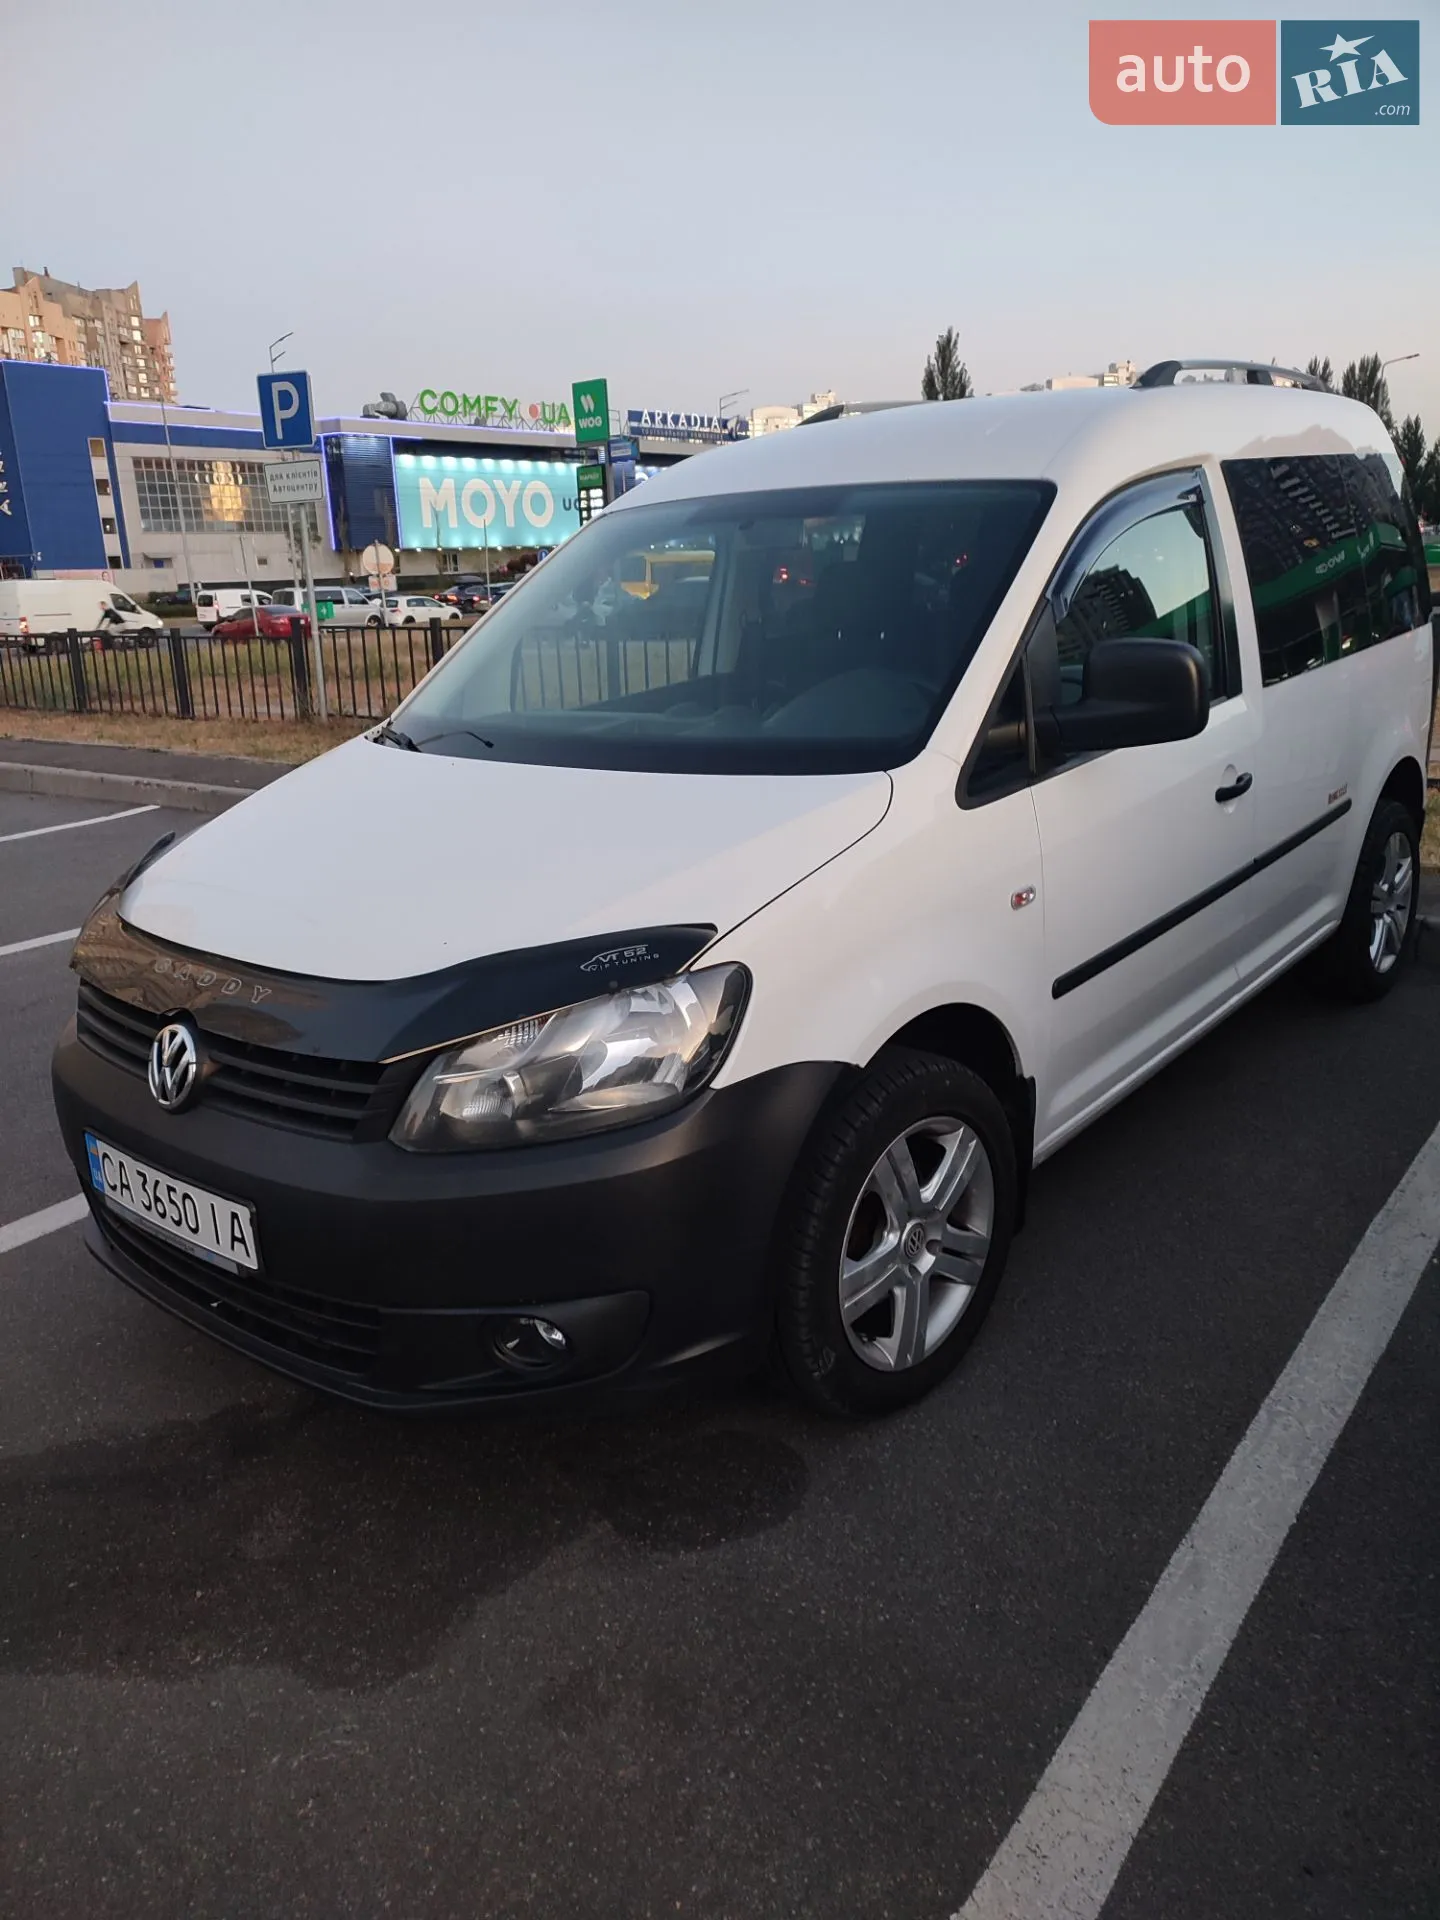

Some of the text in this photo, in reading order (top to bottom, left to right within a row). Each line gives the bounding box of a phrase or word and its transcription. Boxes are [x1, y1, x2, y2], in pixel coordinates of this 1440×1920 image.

[271, 381, 300, 440] P
[578, 416, 602, 429] WOG
[641, 408, 721, 431] ARKADIA
[418, 477, 554, 528] MOYO
[101, 1151, 135, 1204] CA
[136, 1169, 200, 1235] 3650
[210, 1202, 251, 1259] IA
